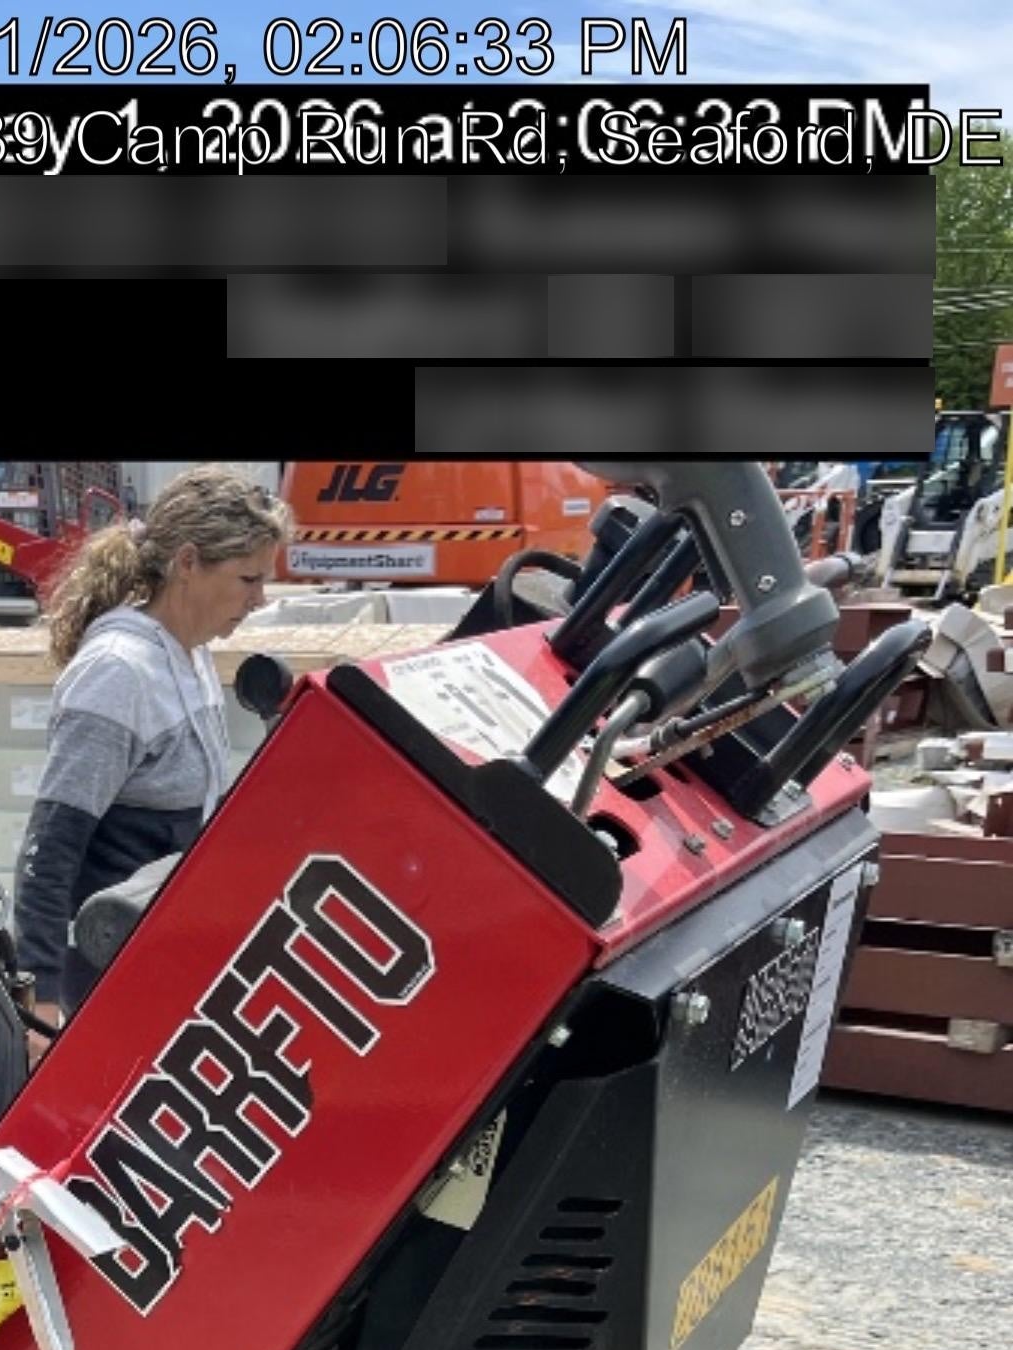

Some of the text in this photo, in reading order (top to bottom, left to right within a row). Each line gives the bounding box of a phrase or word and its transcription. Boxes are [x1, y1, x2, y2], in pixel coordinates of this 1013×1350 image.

[317, 465, 405, 502] JLG
[301, 551, 423, 571] EquipmentShare
[66, 855, 435, 1317] BARRETO
